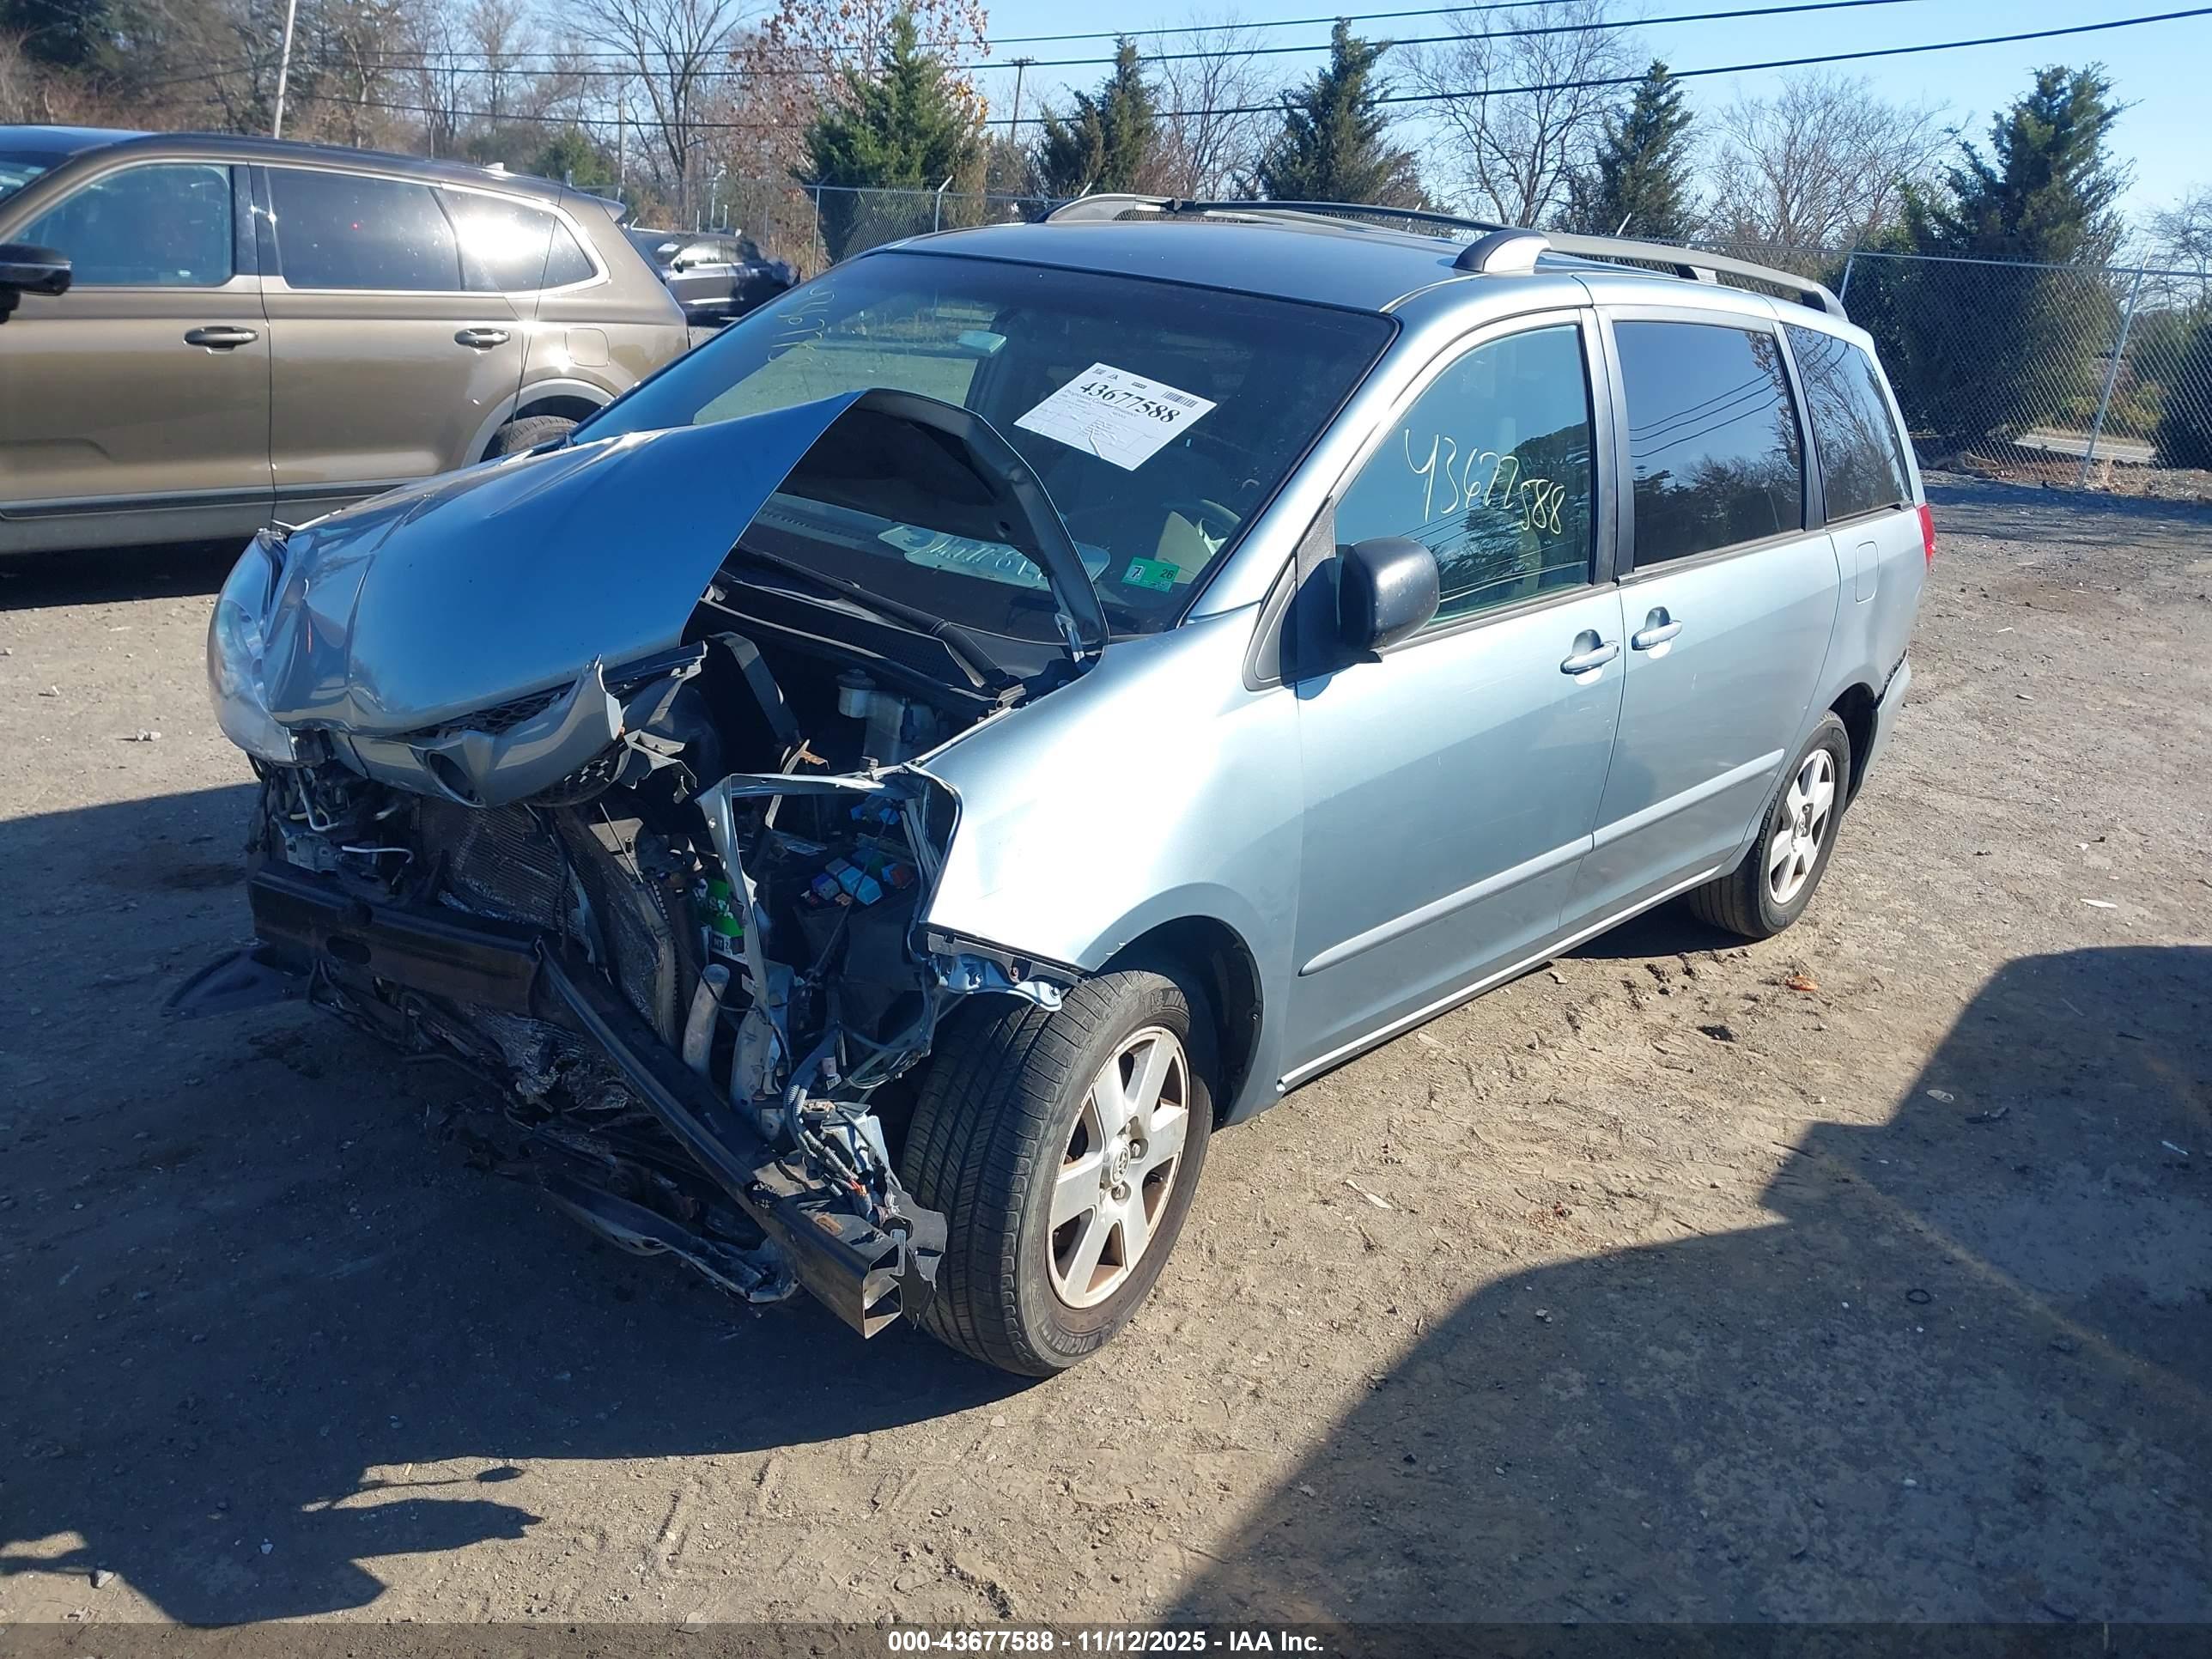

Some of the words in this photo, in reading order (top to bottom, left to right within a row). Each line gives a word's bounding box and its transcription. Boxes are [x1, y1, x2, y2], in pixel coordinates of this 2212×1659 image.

[1079, 381, 1182, 423] 43677588
[1132, 567, 1142, 578] 7
[1159, 568, 1175, 580] 26
